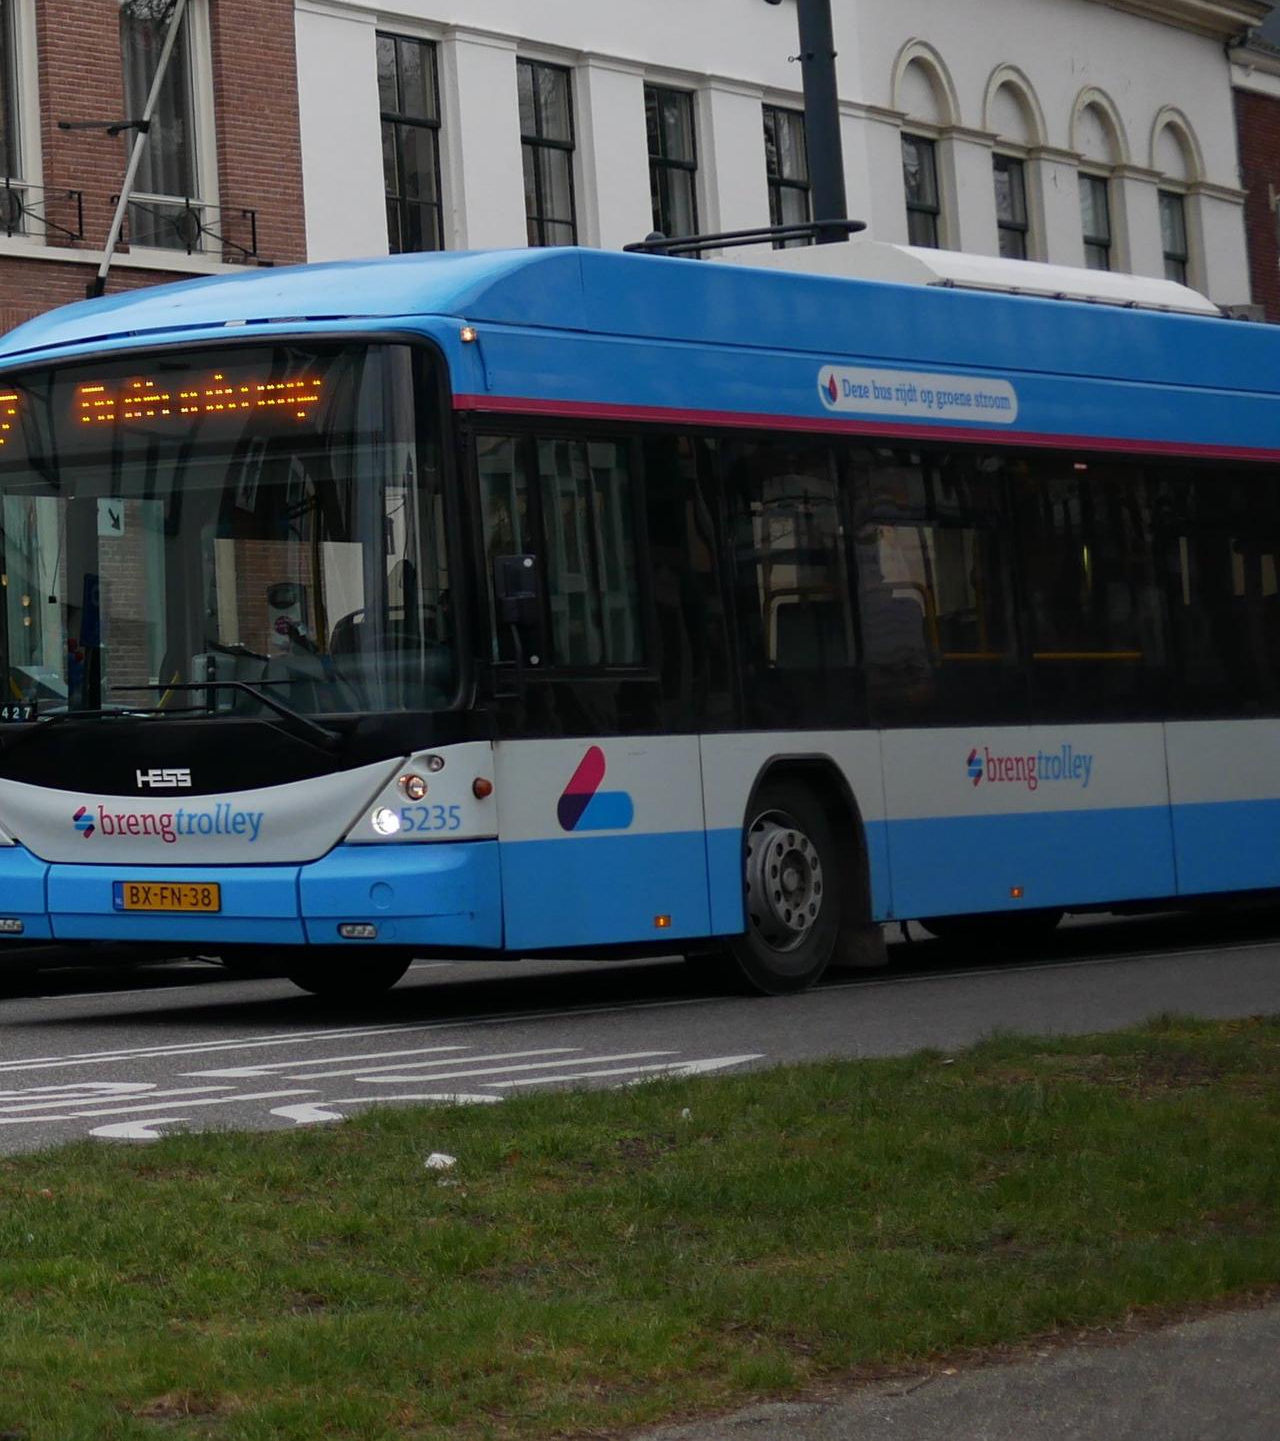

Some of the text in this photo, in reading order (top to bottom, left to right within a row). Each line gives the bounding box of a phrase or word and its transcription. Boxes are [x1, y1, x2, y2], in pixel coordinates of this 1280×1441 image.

[842, 378, 1011, 410] Deze bus rijdt op groene stroom
[136, 768, 192, 788] HESS
[984, 744, 1093, 791] brengtrolley
[97, 803, 264, 843] brengtrolley
[400, 804, 461, 832] 5235
[130, 885, 212, 907] BX-FN-38
